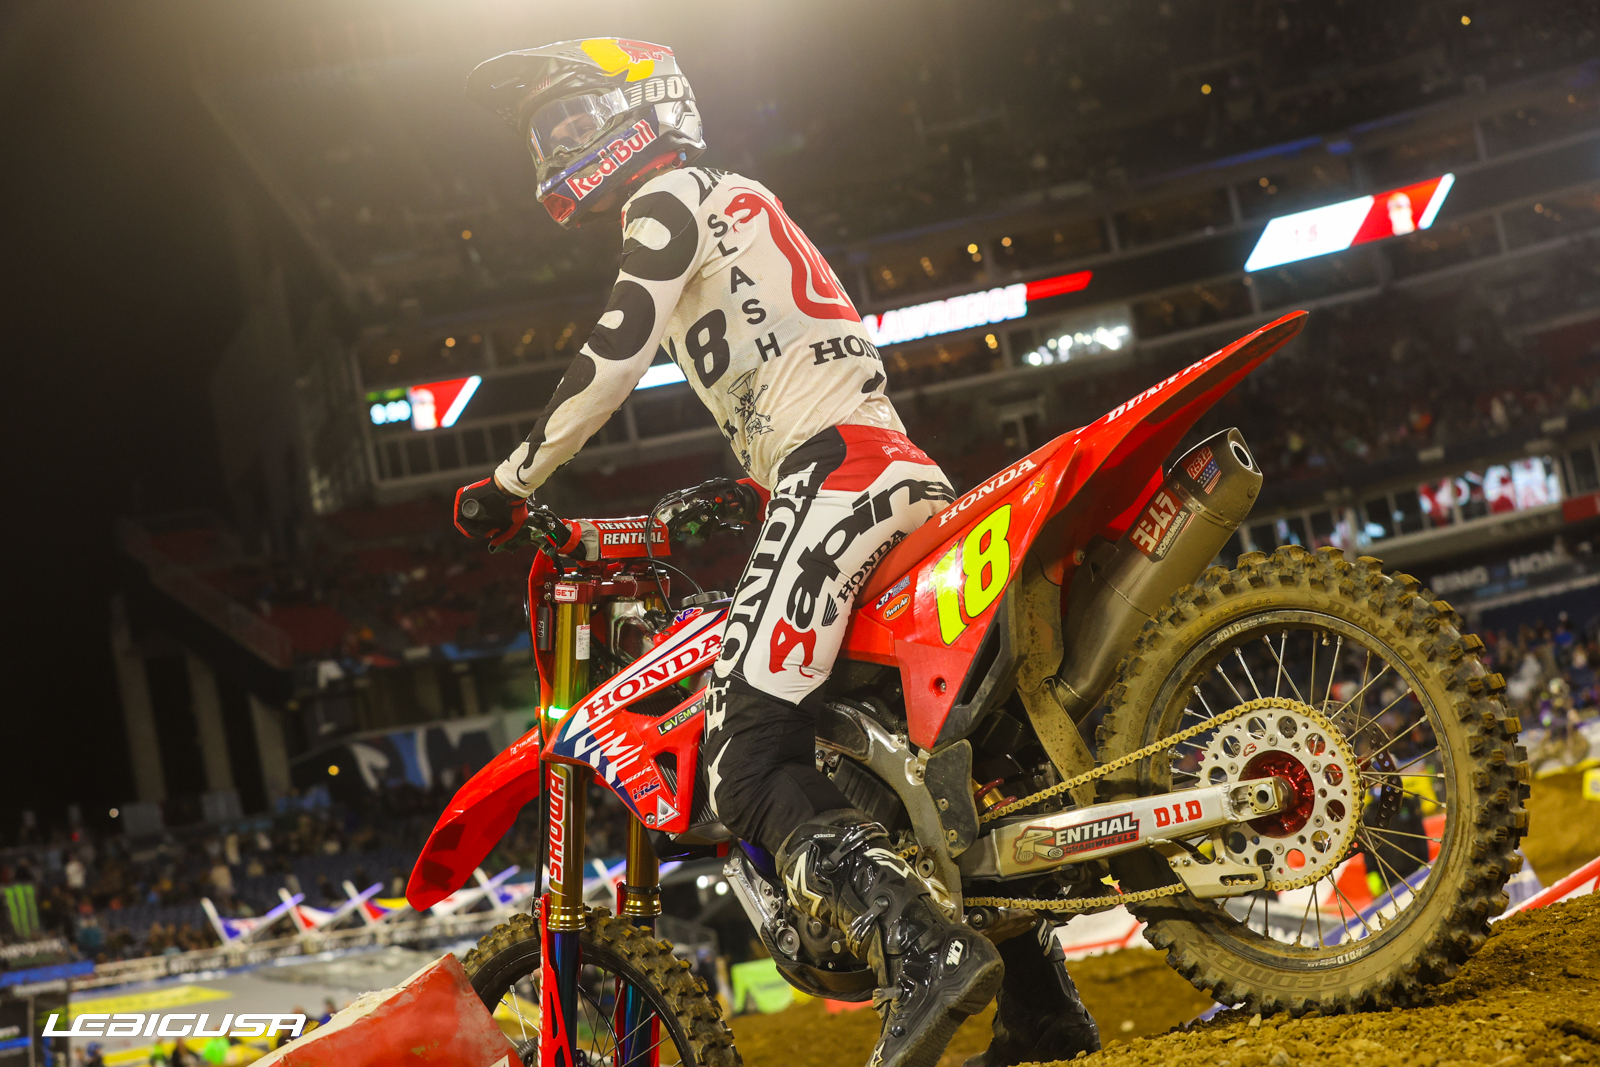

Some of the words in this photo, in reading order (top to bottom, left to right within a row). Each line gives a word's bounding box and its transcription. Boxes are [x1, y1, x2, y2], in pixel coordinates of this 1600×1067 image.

[565, 149, 620, 201] Red
[606, 117, 658, 166] Bull
[669, 309, 731, 390] 8
[809, 334, 882, 366] HON
[938, 459, 1037, 527] HONDA
[1131, 491, 1177, 553] ヨシムラ
[603, 531, 665, 545] RENTHAL
[837, 529, 909, 604] HONDA
[556, 588, 575, 597] GET
[704, 462, 818, 742] HONDA
[925, 502, 1013, 647] 18
[1326, 599, 1433, 682] DUNLOP
[583, 633, 723, 723] HONDA
[657, 698, 706, 735] LOVEMOT
[573, 717, 646, 787] CRF
[616, 765, 653, 789] 450R
[632, 776, 660, 801] HRC
[548, 768, 566, 888] SHOWA
[1065, 832, 1137, 855] CHAINWHEELS
[1186, 934, 1349, 990] GEOMAX
